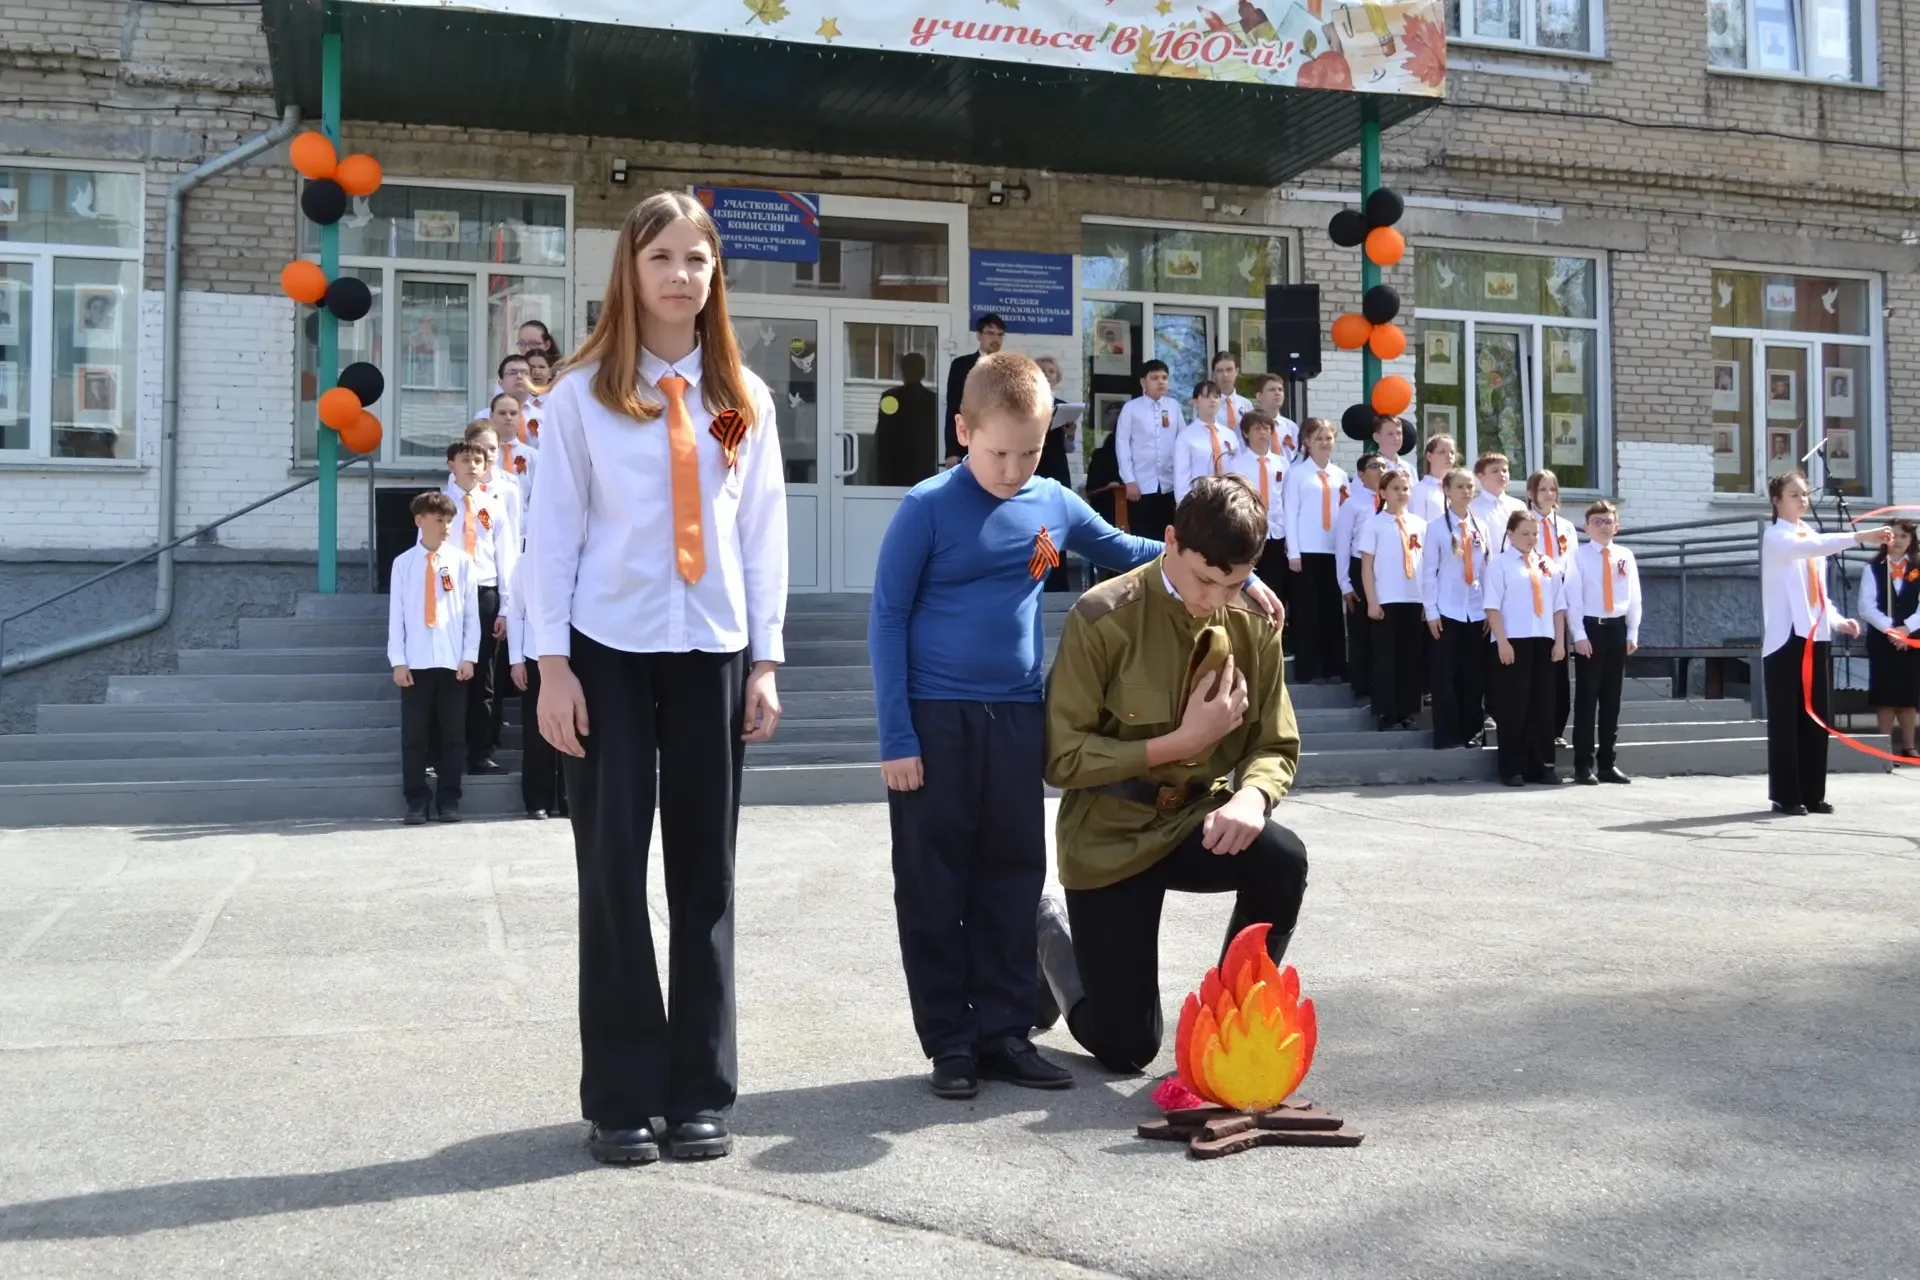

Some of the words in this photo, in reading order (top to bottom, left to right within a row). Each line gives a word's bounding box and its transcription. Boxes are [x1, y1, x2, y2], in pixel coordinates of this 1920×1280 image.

[910, 16, 1097, 51] учиться
[1111, 26, 1138, 55] в
[1154, 28, 1295, 71] 160-й!
[724, 199, 790, 211] УЧАСТКОВЫЕ
[714, 209, 800, 222] ИЗБИРАТЕЛЬНЫЕ
[728, 221, 785, 231] КОМИССИИ
[720, 234, 769, 243] ИРАТЕЛЬНЫХ
[769, 237, 806, 245] УЧАСТКОВ
[973, 304, 1070, 315] ОБЩЕОБРАЗОВАТЕЛЬНАЯ
